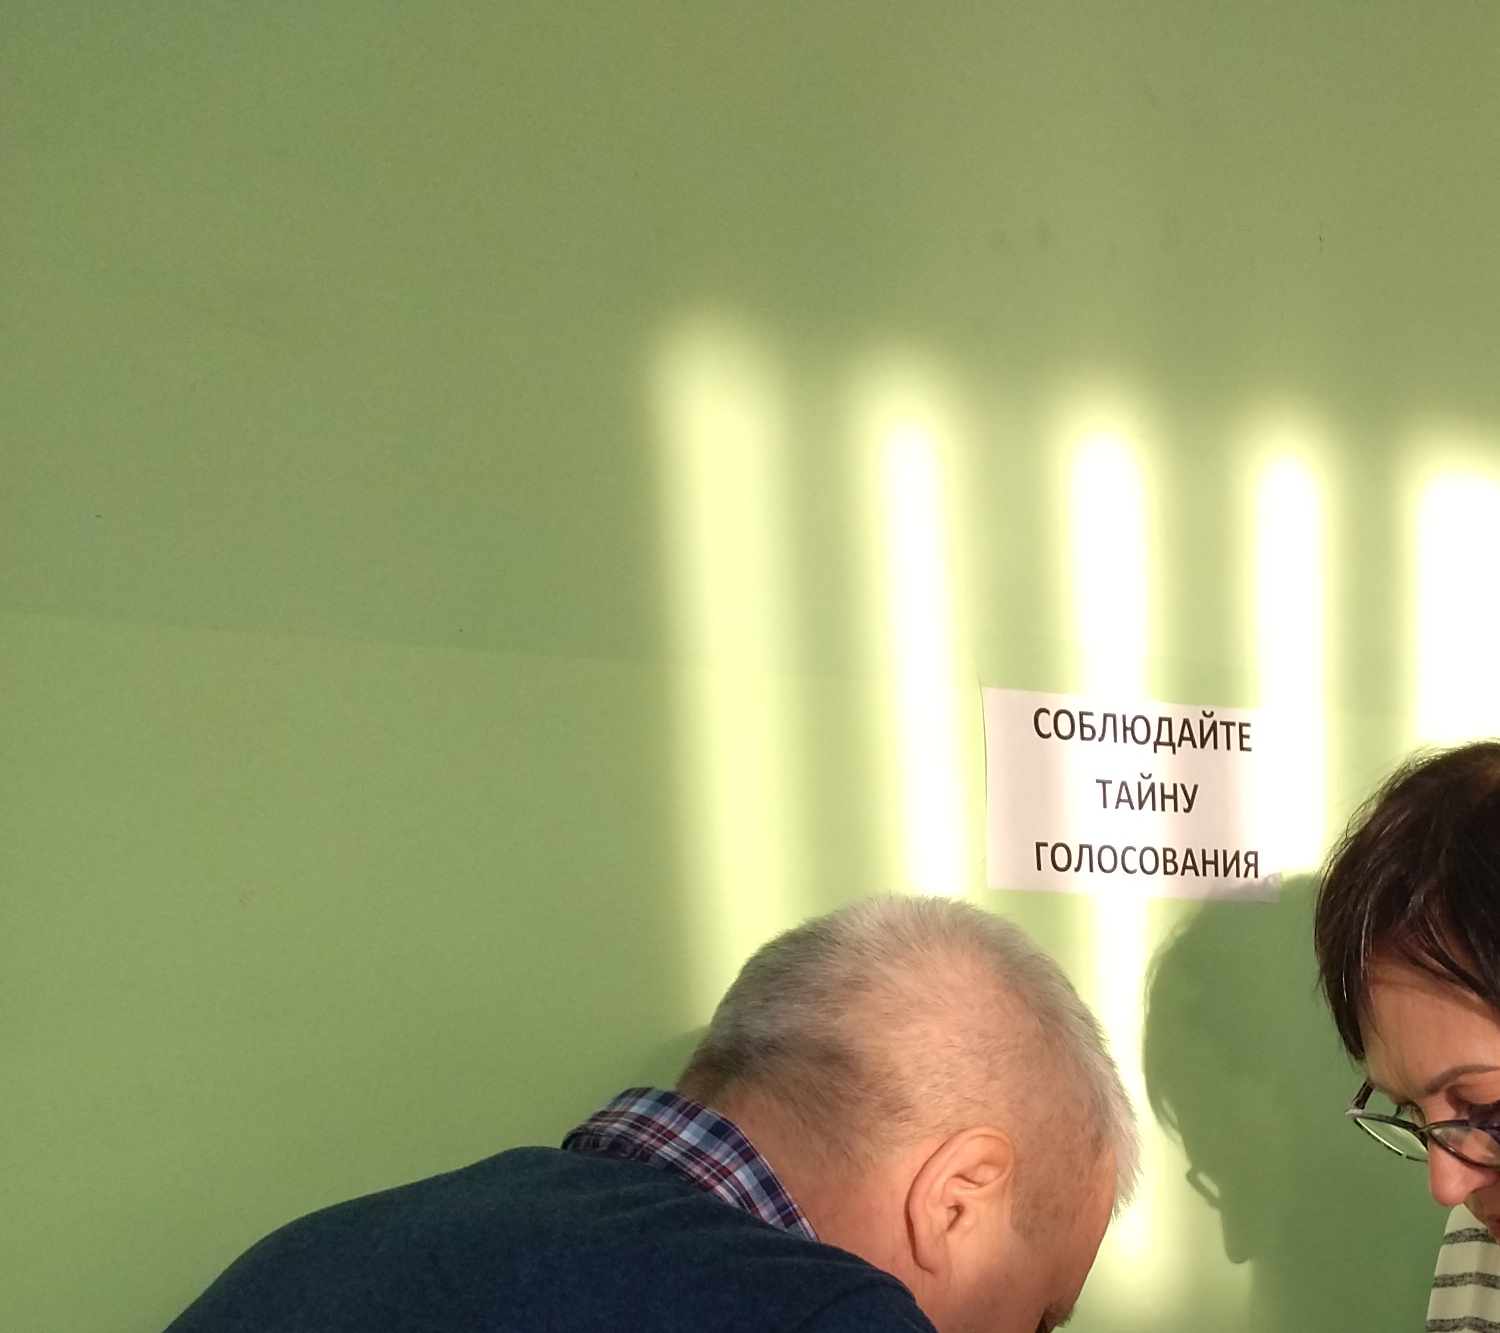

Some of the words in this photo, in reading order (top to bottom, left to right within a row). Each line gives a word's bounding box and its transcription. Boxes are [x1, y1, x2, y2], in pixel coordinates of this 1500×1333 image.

[1033, 708, 1252, 755] СОБЛЮДАЙТЕ
[1095, 772, 1199, 814] ТАЙНУ
[1034, 841, 1259, 879] ГОЛОСОВАНИЯ
